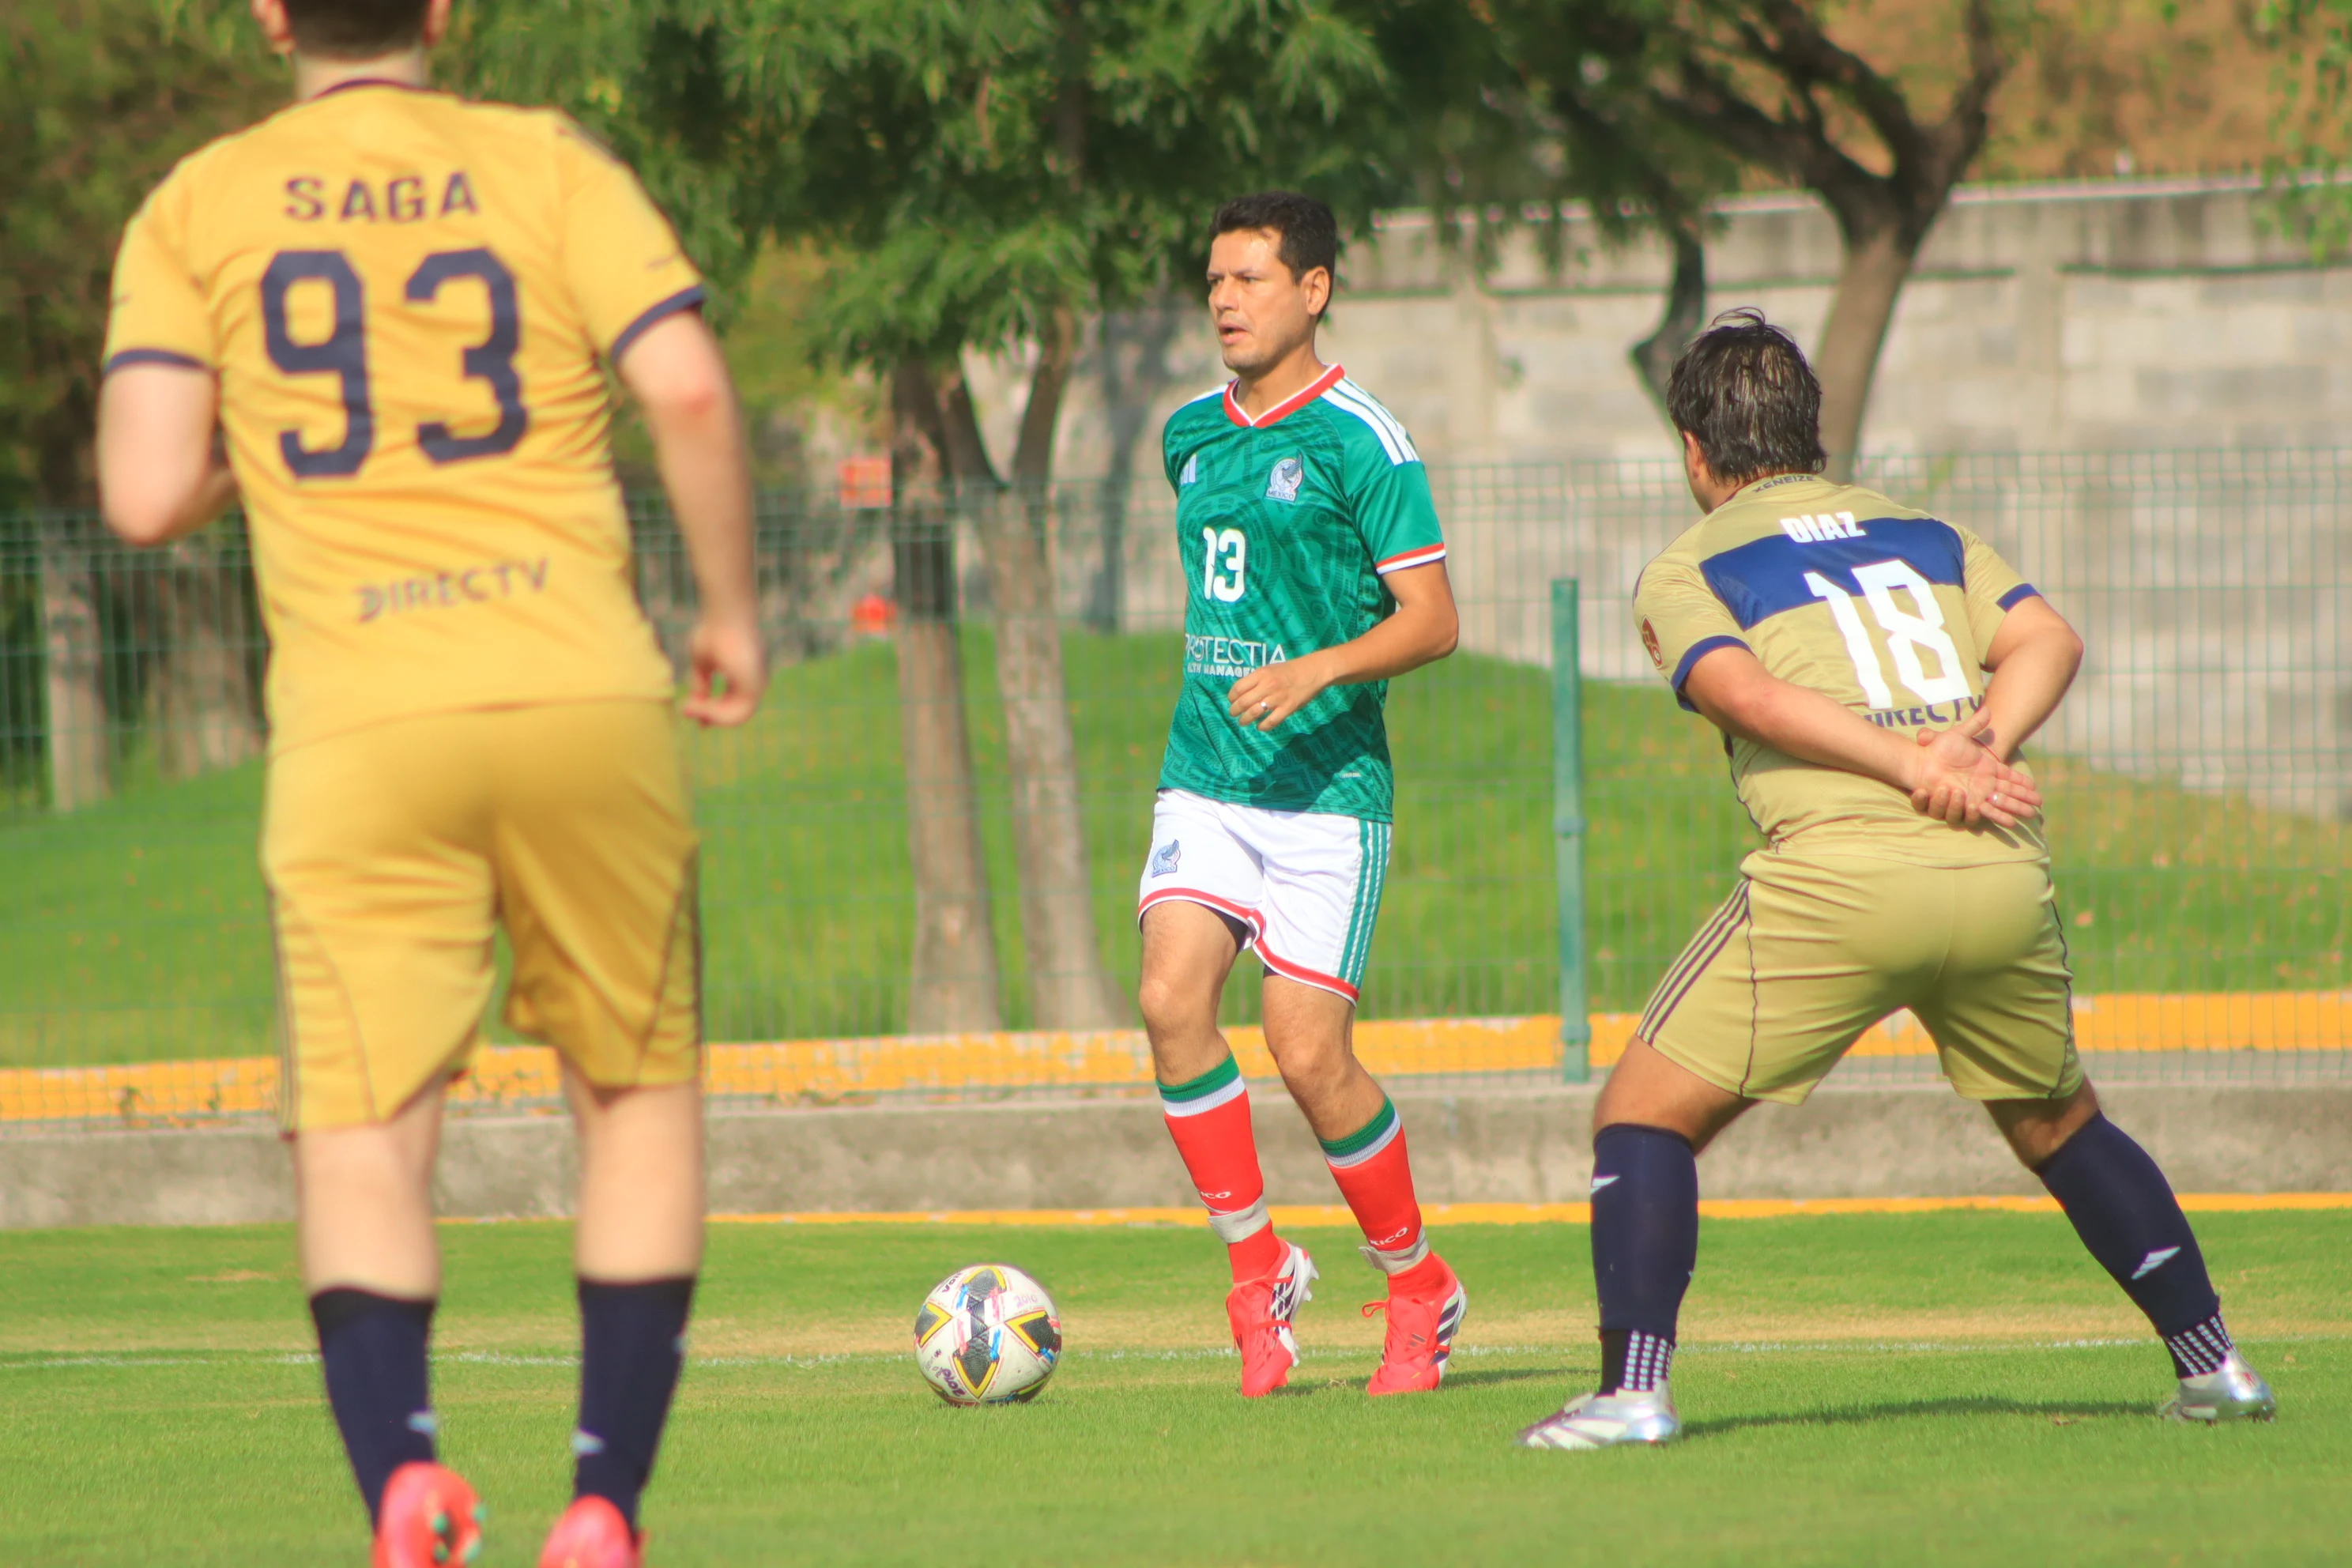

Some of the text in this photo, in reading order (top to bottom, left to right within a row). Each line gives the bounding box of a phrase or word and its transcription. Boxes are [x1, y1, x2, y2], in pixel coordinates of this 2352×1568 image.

[285, 171, 479, 223] SAGA
[259, 247, 529, 479] 93
[1780, 511, 1867, 543] DIAZ
[353, 556, 548, 624] DIRECTV
[1203, 527, 1246, 602] 13
[1804, 560, 1971, 709] 18
